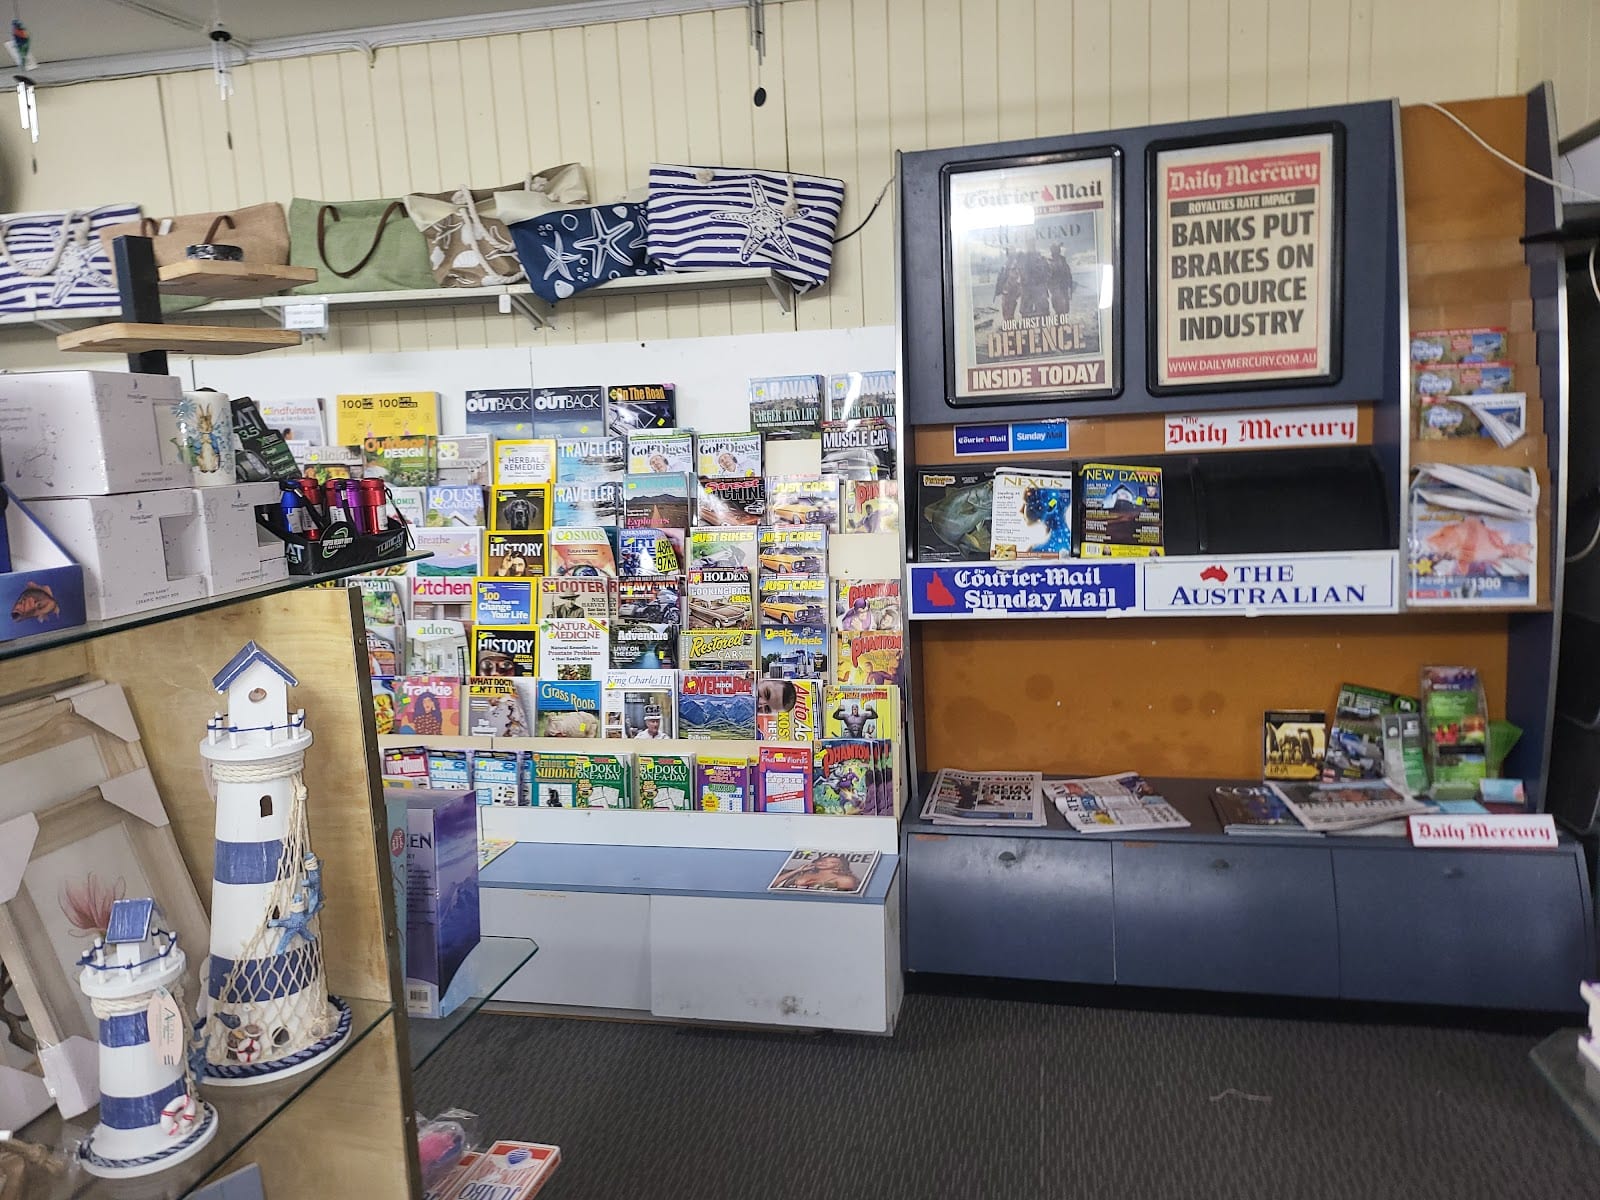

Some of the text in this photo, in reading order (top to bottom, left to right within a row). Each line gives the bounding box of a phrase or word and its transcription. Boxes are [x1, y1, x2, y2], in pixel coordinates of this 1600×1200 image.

[1169, 161, 1318, 192] Daily Mercury
[1055, 180, 1103, 200] Mail
[1188, 192, 1297, 215] ROYALTIES RATE IMPACT
[1171, 210, 1315, 248] BANKS PUT
[1171, 243, 1314, 280] BRAKES ON
[1177, 276, 1307, 311] RESOURCE
[1002, 313, 1069, 331] OUR FIRST LINE OF
[1179, 308, 1305, 342] INDUSTRY
[987, 323, 1087, 358] DEFENCE
[1168, 352, 1317, 373] WWW.DAILYMERCURY.COM.AU
[972, 363, 1100, 390] INSIDE TODAY
[617, 386, 666, 400] On The Road
[342, 400, 361, 409] 100
[378, 399, 398, 408] 100
[466, 395, 532, 412] OUTBACK
[535, 393, 601, 410] OUTBACK
[263, 406, 316, 416] indfulness
[782, 407, 800, 421] THAN
[802, 407, 819, 422] LIFE
[1181, 415, 1198, 425] The
[823, 429, 889, 448] MUSCLE CAR
[958, 434, 1007, 444] Courier Mail
[1016, 432, 1047, 443] Sunday
[1167, 418, 1355, 446] Daily Mercury
[383, 447, 424, 458] DESIGN
[559, 441, 624, 457] TRAVELLER
[631, 441, 691, 457] Golf Digest
[700, 439, 760, 456] Golf Digest
[304, 449, 361, 461] dlicious
[508, 456, 541, 464] HERBAL
[1003, 476, 1063, 490] NEXUS
[1086, 469, 1158, 483] NEW DAWN
[428, 488, 482, 502] HOUSE
[555, 486, 615, 502] TRAVELLER
[417, 534, 450, 545] Breathe
[556, 530, 606, 541] COSMOS
[760, 531, 822, 542] JUST CARS
[490, 543, 543, 557] HISTORY
[620, 538, 656, 548] DIRT
[954, 567, 1102, 588] Courier-Mail
[1233, 564, 1294, 582] THE
[413, 577, 473, 595] kitchen
[691, 587, 729, 596] LOOKING
[762, 580, 826, 591] JUST CARS
[483, 591, 500, 601] 100
[849, 582, 899, 610] PHANTOM
[964, 587, 1117, 611] Sunday Mail
[1171, 584, 1368, 606] AUSTRALIAN
[479, 602, 512, 613] Change
[491, 610, 529, 619] Your Life
[417, 624, 455, 635] adore
[550, 622, 601, 631] NATURAL
[617, 630, 669, 641] Adventure
[765, 628, 793, 640] Deals
[784, 636, 823, 645] Wheels
[478, 639, 534, 653] HISTORY
[690, 632, 744, 658] Restored
[851, 635, 902, 668] PHANTOM
[717, 650, 744, 660] CARS
[470, 677, 493, 685] WHAT
[606, 674, 671, 688] King Charles III
[682, 675, 752, 695] ADVENTURE
[402, 681, 453, 697] frankie
[470, 686, 493, 694] DN'T
[541, 683, 569, 702] Grass
[570, 693, 596, 712] Roots
[824, 741, 871, 778] PHANTOM
[535, 767, 577, 779] SUDOKU
[577, 762, 621, 775] SUDOKU
[640, 763, 687, 776] SUDOKU
[576, 772, 622, 781] ONE-A-DAY
[640, 773, 687, 782] ONE-A-DAY
[1418, 821, 1552, 841] Daily Mercury
